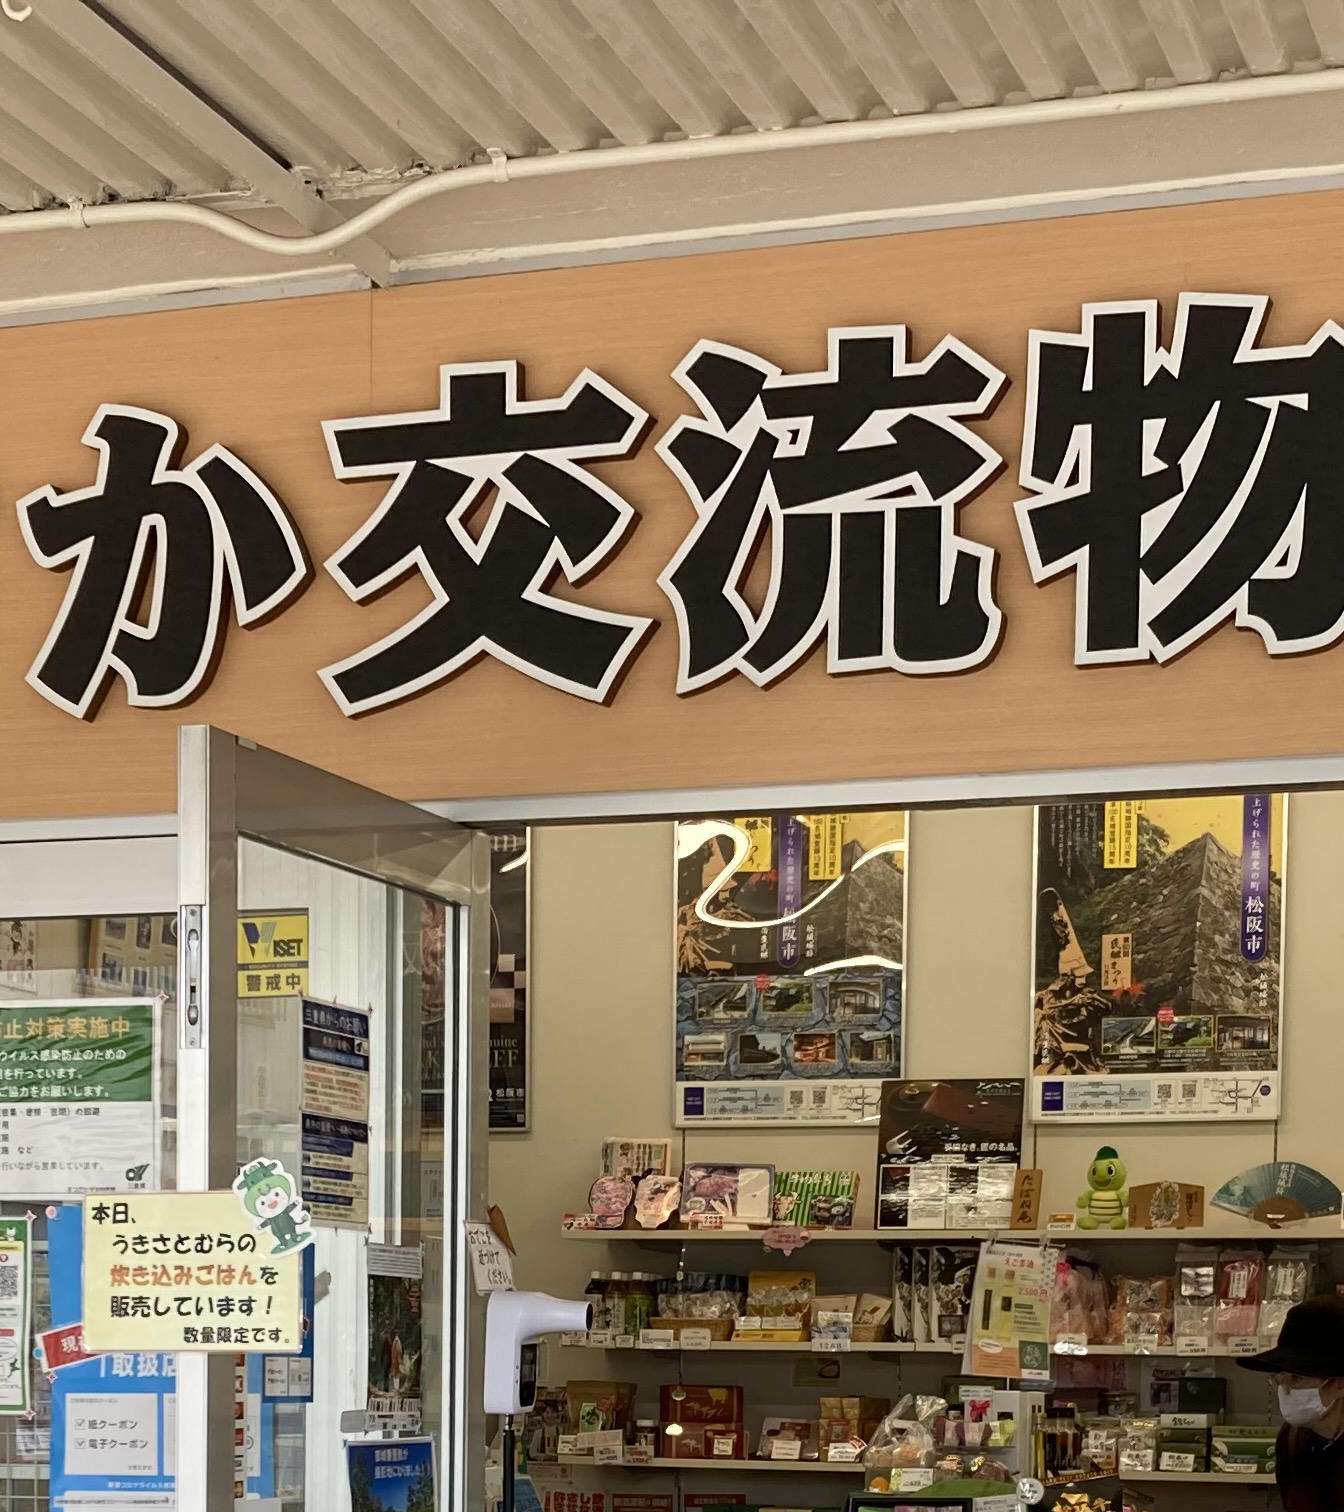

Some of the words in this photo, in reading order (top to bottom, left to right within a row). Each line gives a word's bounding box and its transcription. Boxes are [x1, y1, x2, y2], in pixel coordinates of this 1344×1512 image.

[1244, 895, 1265, 955] 松阪市
[246, 972, 302, 992] 警戒中
[91, 1202, 137, 1225] 本日、
[112, 1233, 256, 1255] うきさとむらの
[110, 1263, 280, 1288] 炊き込みごはんを
[110, 1295, 274, 1319] 販売しています！
[183, 1326, 291, 1345] 数量限定です。
[88, 1438, 149, 1450] 電子クーポン
